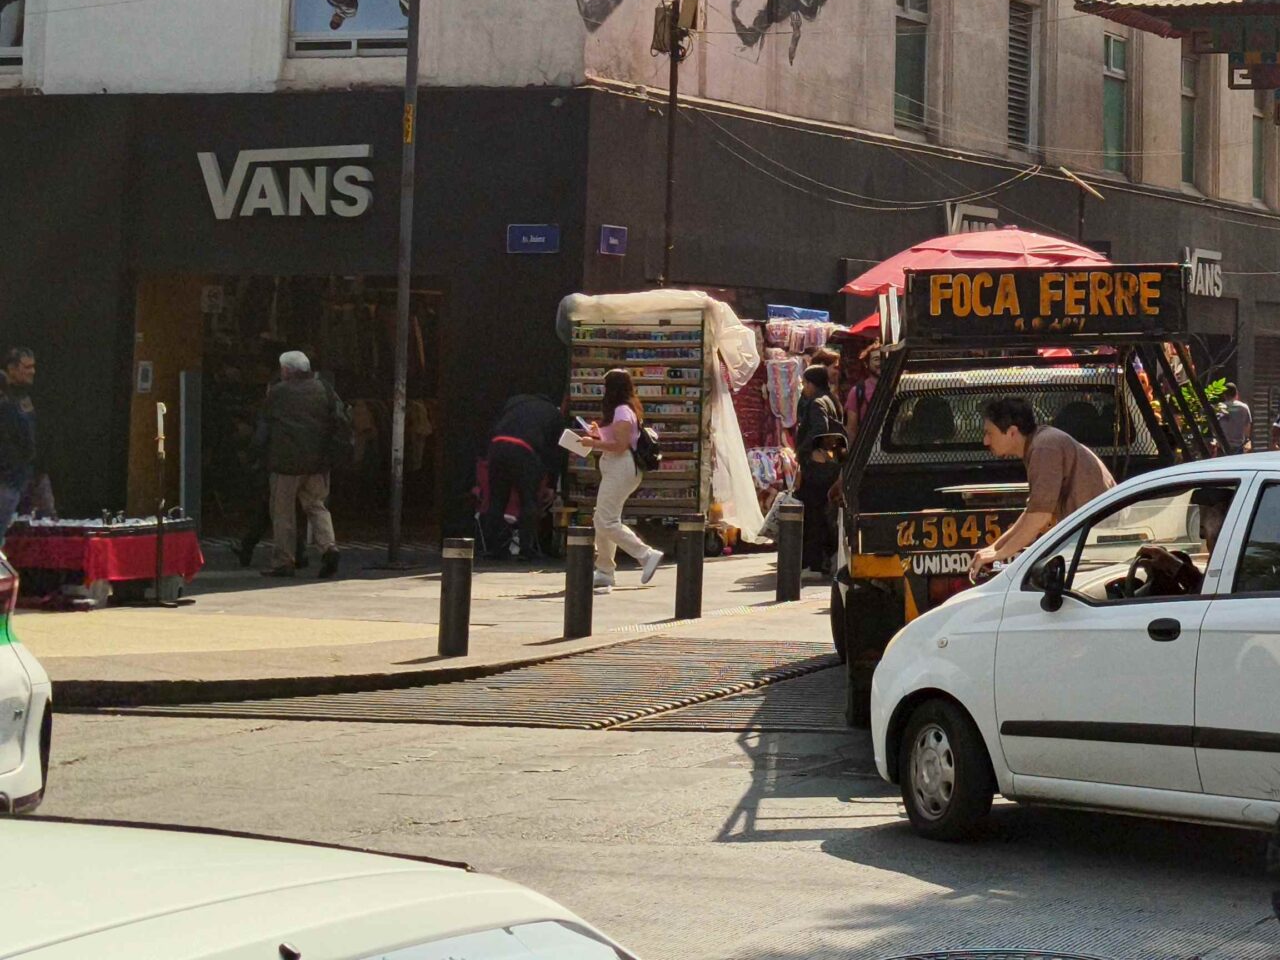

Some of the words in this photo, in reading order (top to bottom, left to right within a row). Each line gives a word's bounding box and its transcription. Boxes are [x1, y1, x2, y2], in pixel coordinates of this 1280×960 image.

[197, 144, 374, 220] VANS
[930, 272, 1020, 317] FOCA
[1039, 271, 1162, 316] FERRE
[1185, 246, 1222, 298] VANS
[912, 552, 972, 575] UNIDAD
